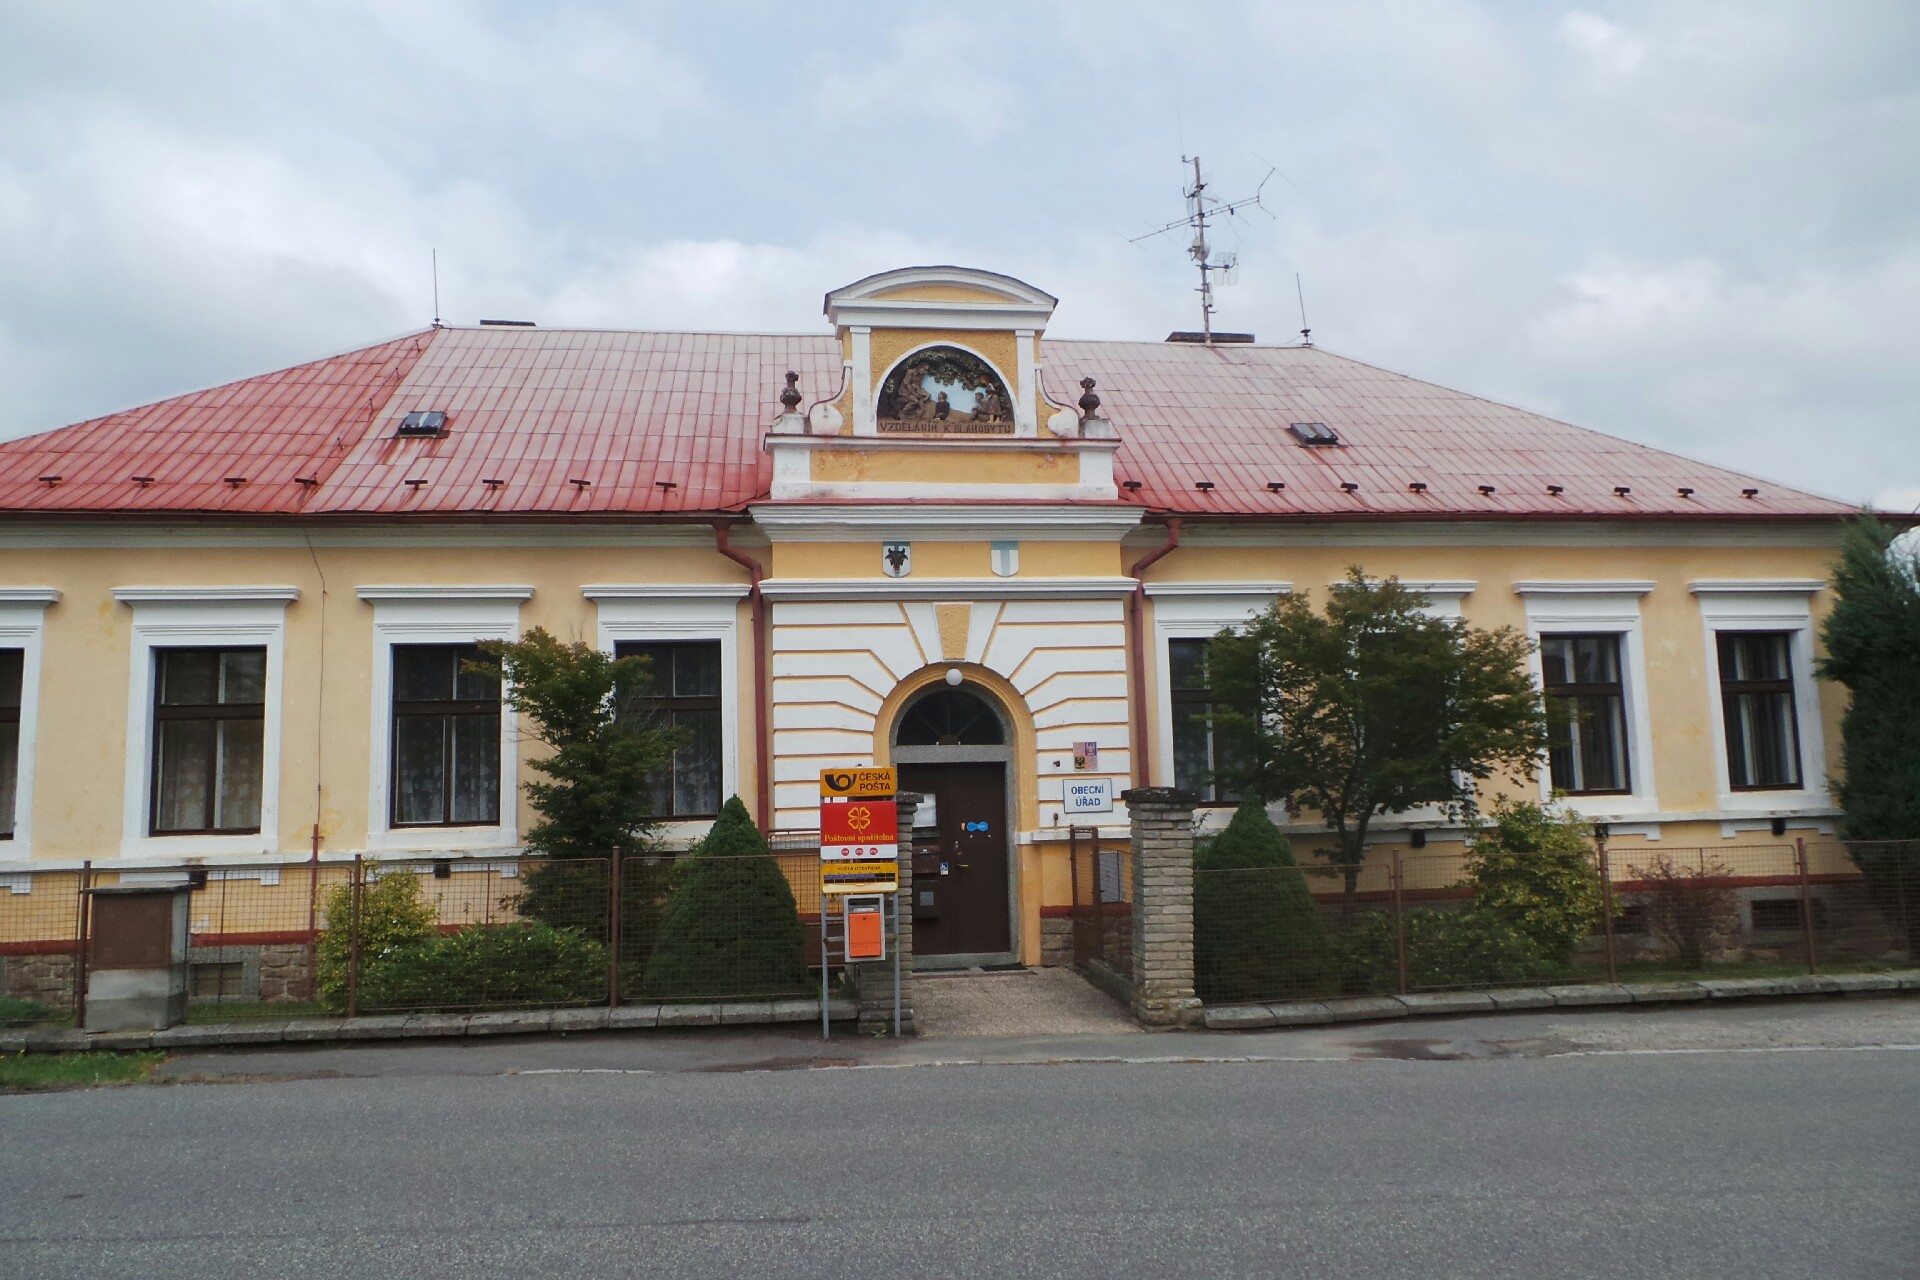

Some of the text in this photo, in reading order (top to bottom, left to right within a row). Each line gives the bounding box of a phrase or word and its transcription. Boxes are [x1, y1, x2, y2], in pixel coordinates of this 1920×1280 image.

[943, 424, 951, 433] K
[954, 424, 1010, 433] BLAHOBYTU
[859, 771, 891, 781] ČESKÁ
[859, 781, 891, 791] POŠTA
[1071, 784, 1104, 794] OBECNÍ
[1076, 796, 1101, 806] ÚŘAD
[824, 833, 894, 843] Poštovní spořitelna
